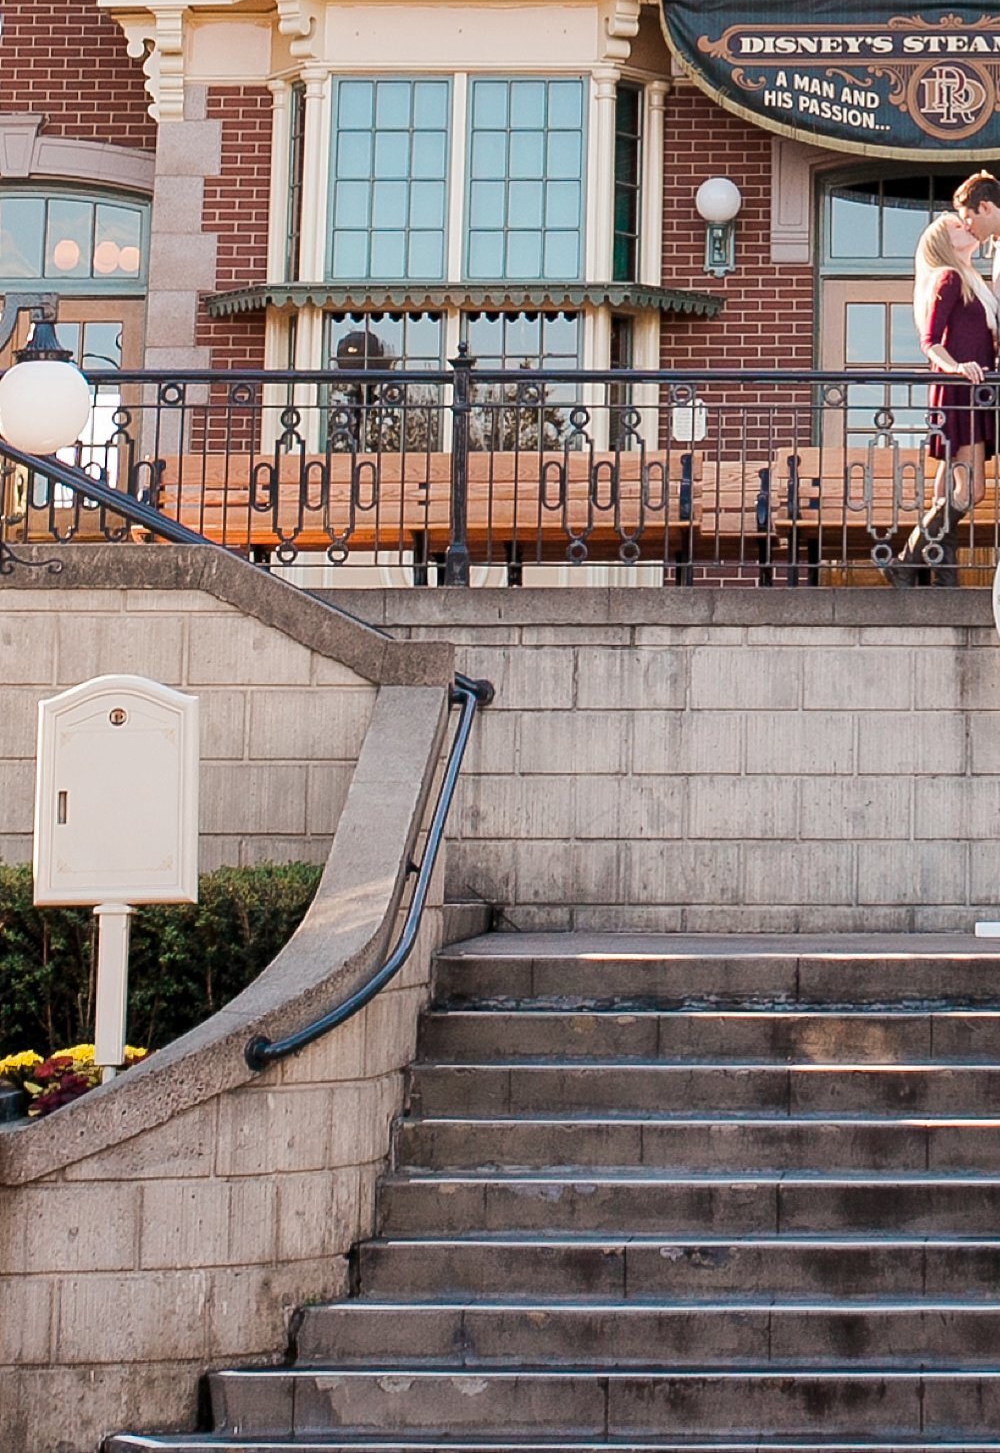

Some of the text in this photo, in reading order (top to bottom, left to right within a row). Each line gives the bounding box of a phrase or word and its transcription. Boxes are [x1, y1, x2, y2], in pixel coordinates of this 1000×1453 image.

[739, 36, 894, 54] DISNEY'S
[763, 89, 891, 131] HIS PASSION...
[775, 70, 880, 110] A MAN AND
